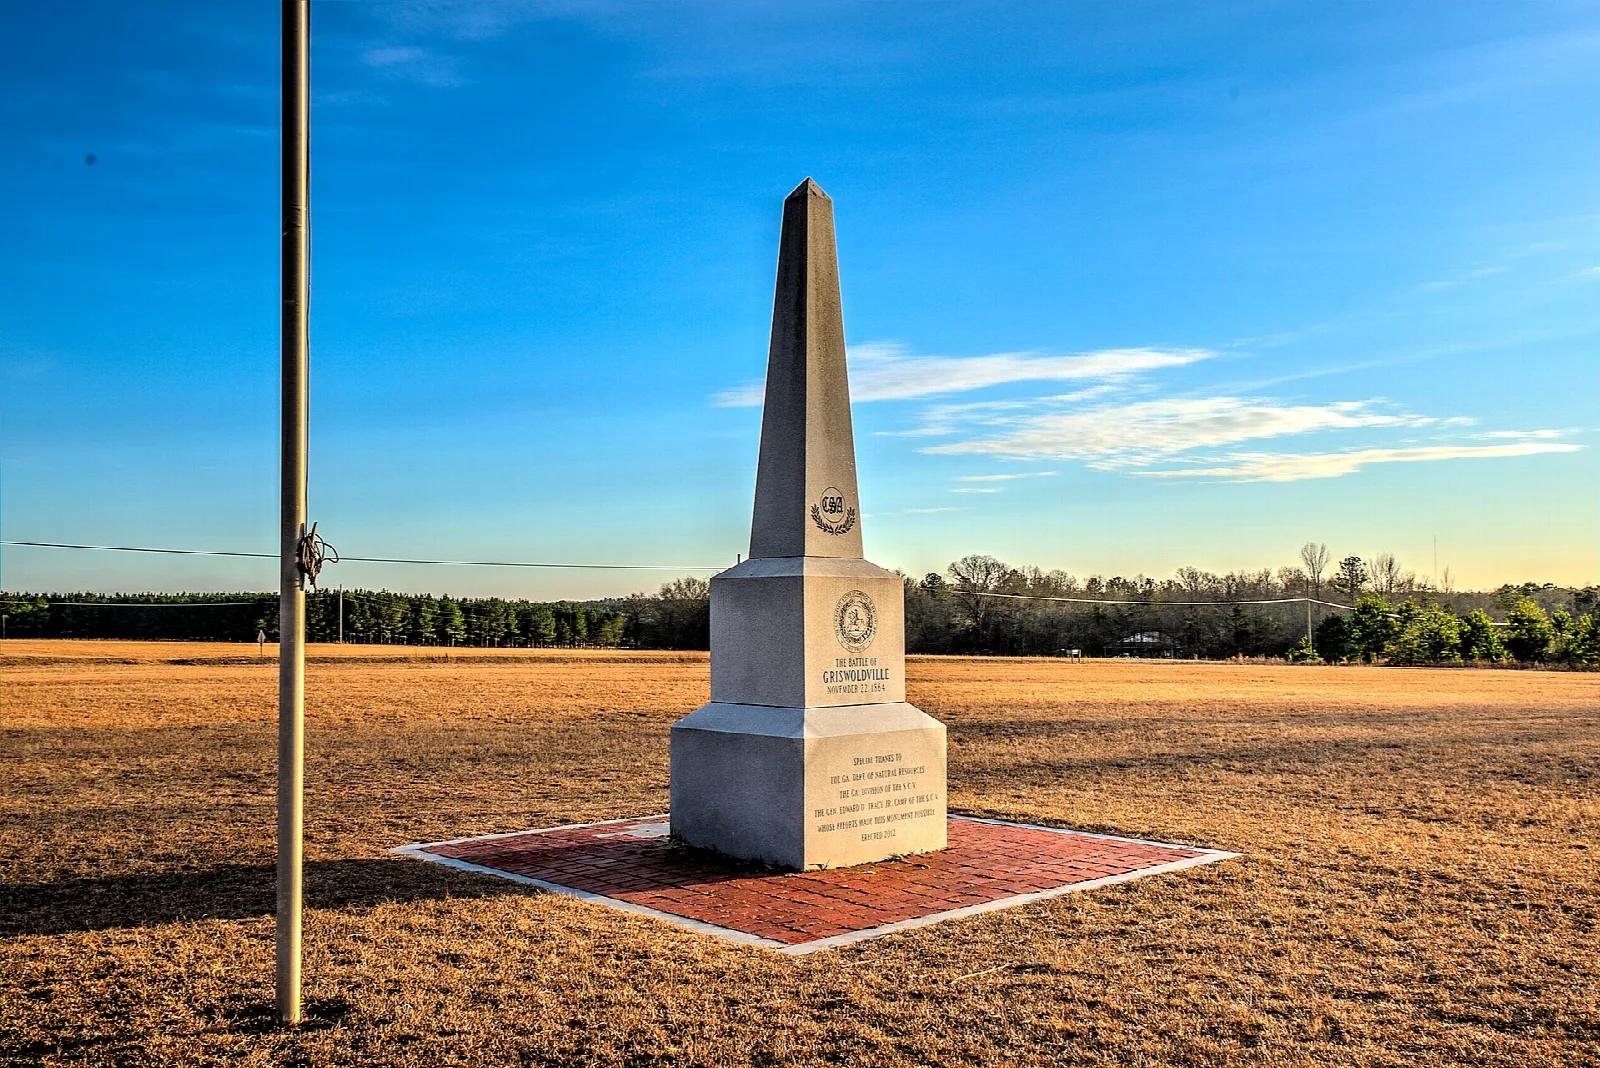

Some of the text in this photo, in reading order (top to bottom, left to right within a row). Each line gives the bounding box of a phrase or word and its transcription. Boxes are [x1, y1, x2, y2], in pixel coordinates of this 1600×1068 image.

[822, 496, 844, 514] CSA
[835, 657, 877, 667] THE BATTLE OF
[823, 668, 890, 683] GRISWOLDVILLE
[827, 684, 858, 694] NOVEMBER
[871, 682, 886, 692] 1864
[853, 752, 903, 766] SPECIAL THANKS TO
[830, 775, 841, 785] THE
[866, 771, 874, 780] OF
[874, 768, 897, 779] NATURAL
[898, 765, 925, 776] RESOURCES
[839, 789, 850, 799] THE
[861, 785, 884, 796] DIVISION
[884, 784, 892, 793] OF
[892, 783, 902, 792] THE
[814, 808, 825, 818] THE
[839, 803, 860, 815] EDWARD
[867, 800, 884, 810] TRACY
[894, 797, 908, 807] CAMP
[908, 796, 915, 805] OF
[915, 794, 925, 804] THE
[817, 808, 936, 833] WHOSE EFFORTS MADE THIS MONUMENT POSSIBLE
[861, 828, 896, 842] ERECTED 2012
